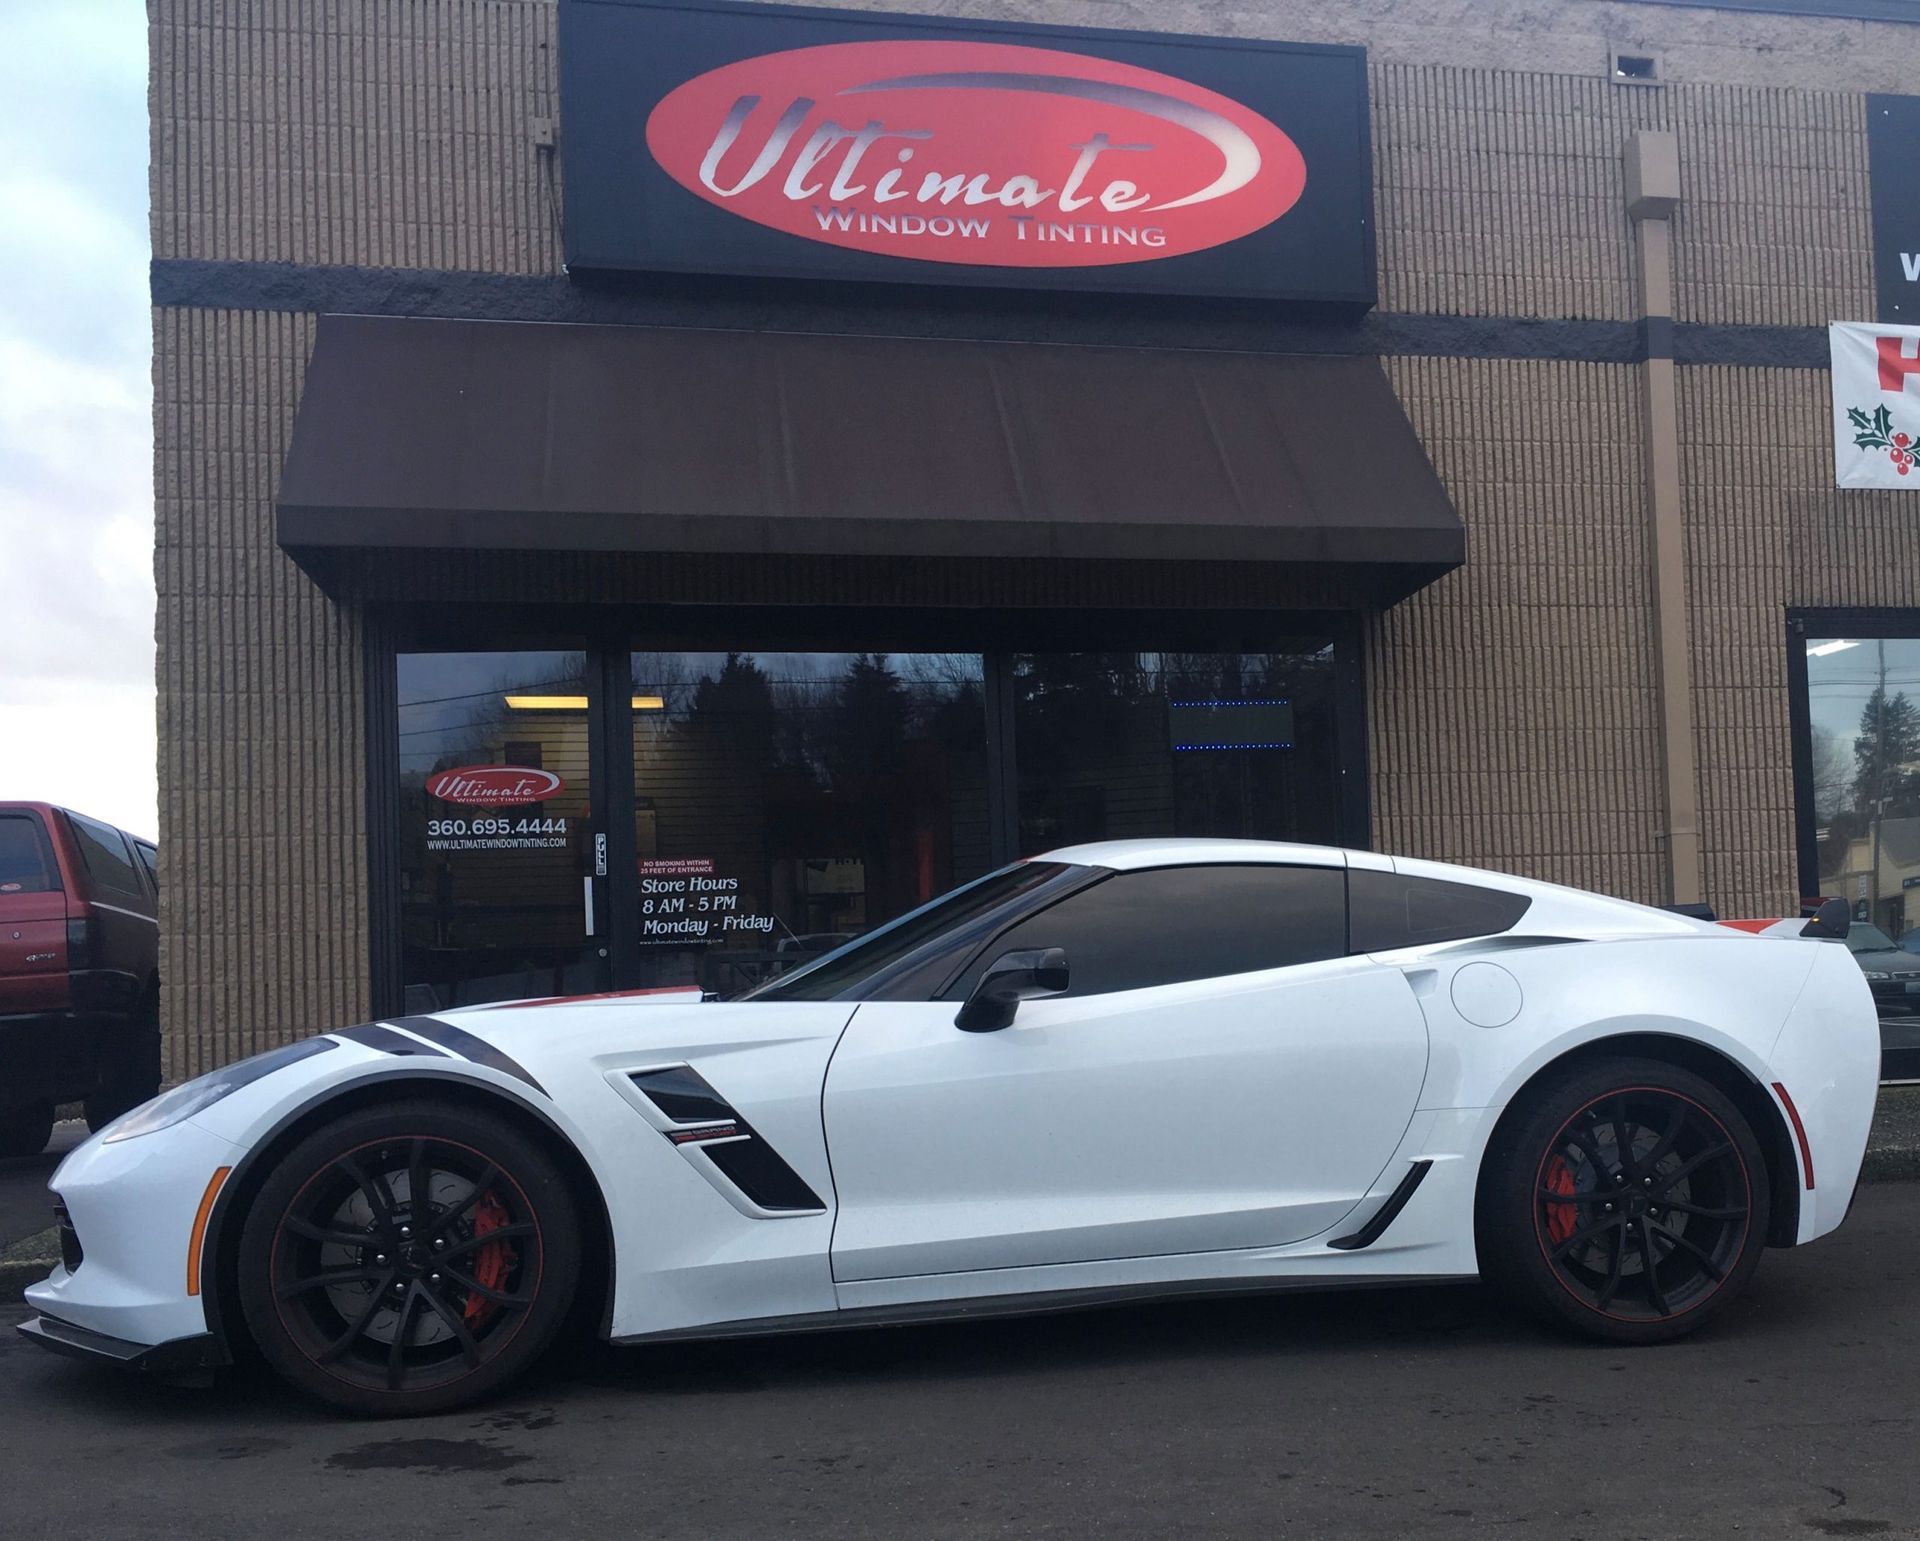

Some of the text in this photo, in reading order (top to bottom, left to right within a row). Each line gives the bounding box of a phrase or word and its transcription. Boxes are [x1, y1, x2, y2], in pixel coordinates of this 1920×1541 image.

[698, 95, 1153, 213] Ultimate
[812, 205, 1168, 247] WINDOW TINTING
[434, 776, 536, 798] Ultimate
[427, 818, 567, 836] 360.695.4444
[427, 837, 567, 850] WWW.ULTIMATEWINDOWTINTING.COM
[597, 837, 605, 866] PULL
[641, 876, 738, 893] Store Hours
[642, 899, 653, 914] 8
[658, 898, 685, 913] AM
[698, 897, 709, 912] 5
[713, 895, 738, 911] PM
[643, 918, 709, 936] Monday
[723, 914, 775, 932] Friday
